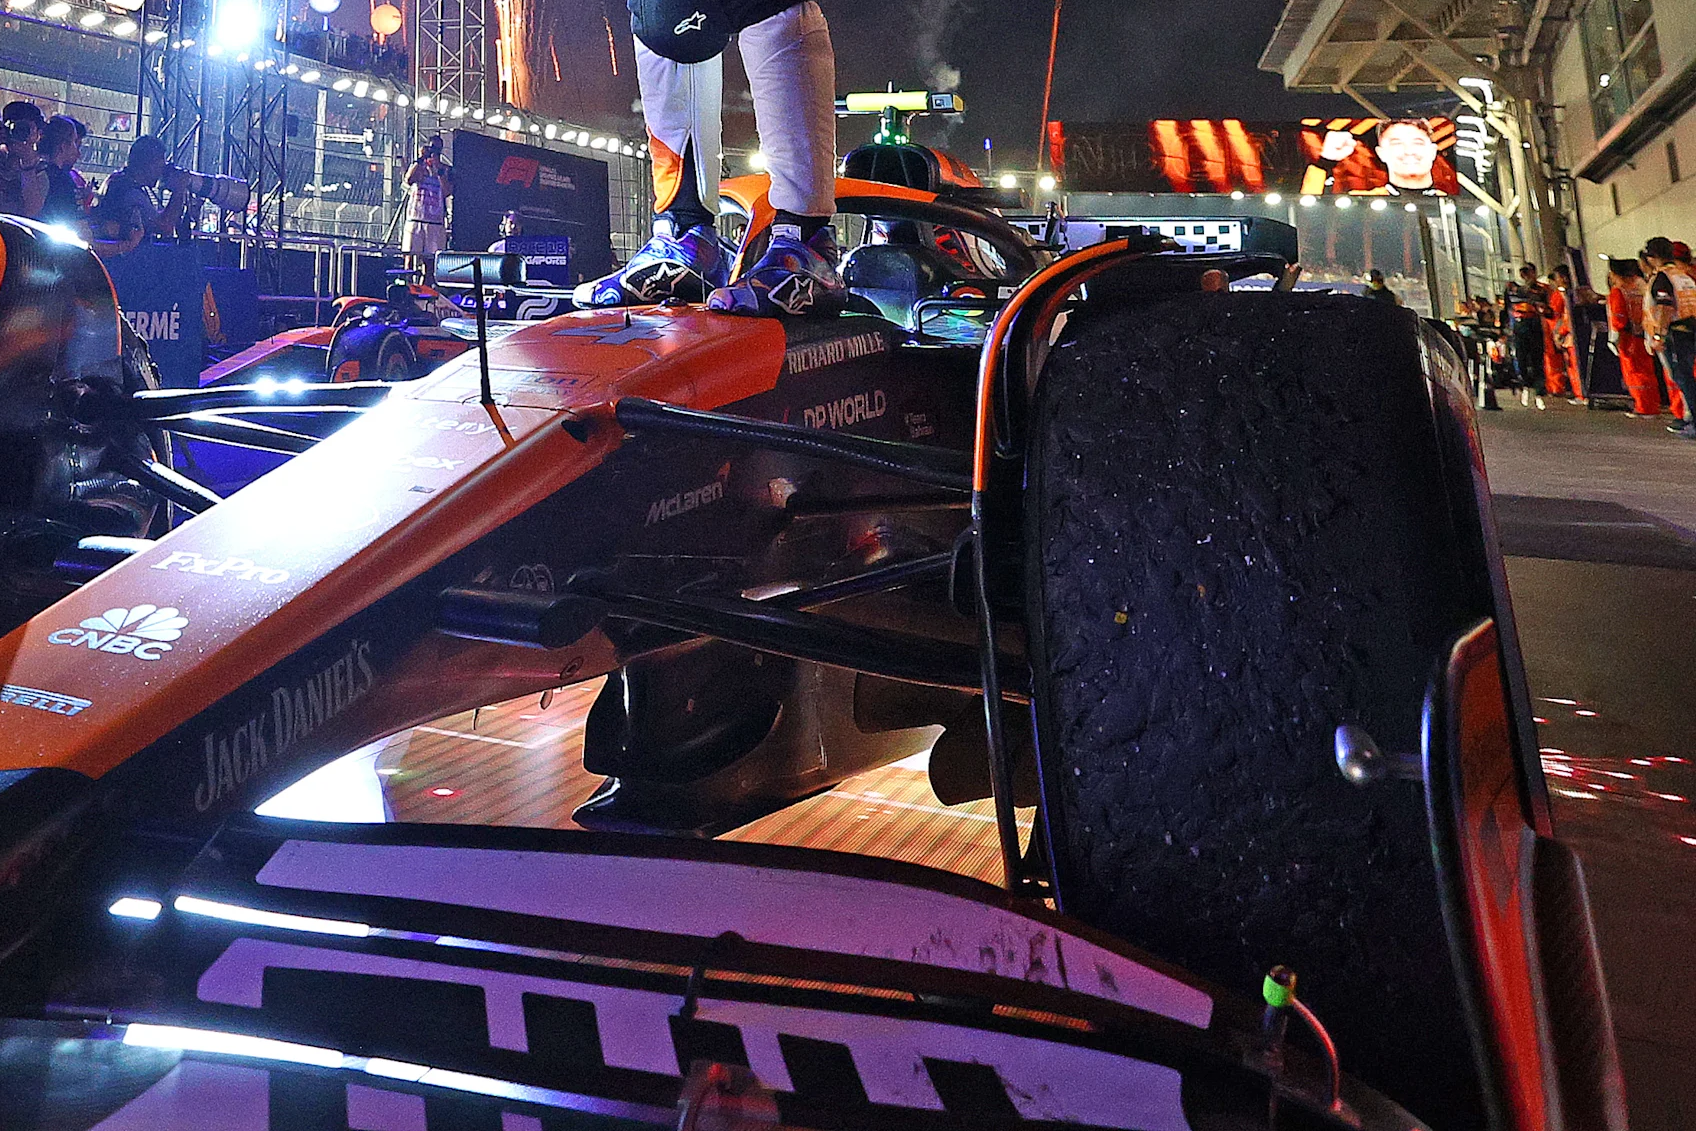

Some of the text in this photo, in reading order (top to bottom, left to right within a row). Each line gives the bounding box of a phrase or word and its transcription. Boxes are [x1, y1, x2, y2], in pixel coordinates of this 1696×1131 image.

[524, 254, 567, 267] GAPORE
[125, 302, 181, 341] ERMÉ
[786, 331, 886, 375] RICHARD MILLE
[804, 403, 827, 430] DP
[826, 389, 887, 430] WORLD
[644, 481, 724, 528] McLaren
[150, 550, 292, 585] FxPro
[47, 627, 174, 662] CNBC
[194, 713, 269, 812] JACK
